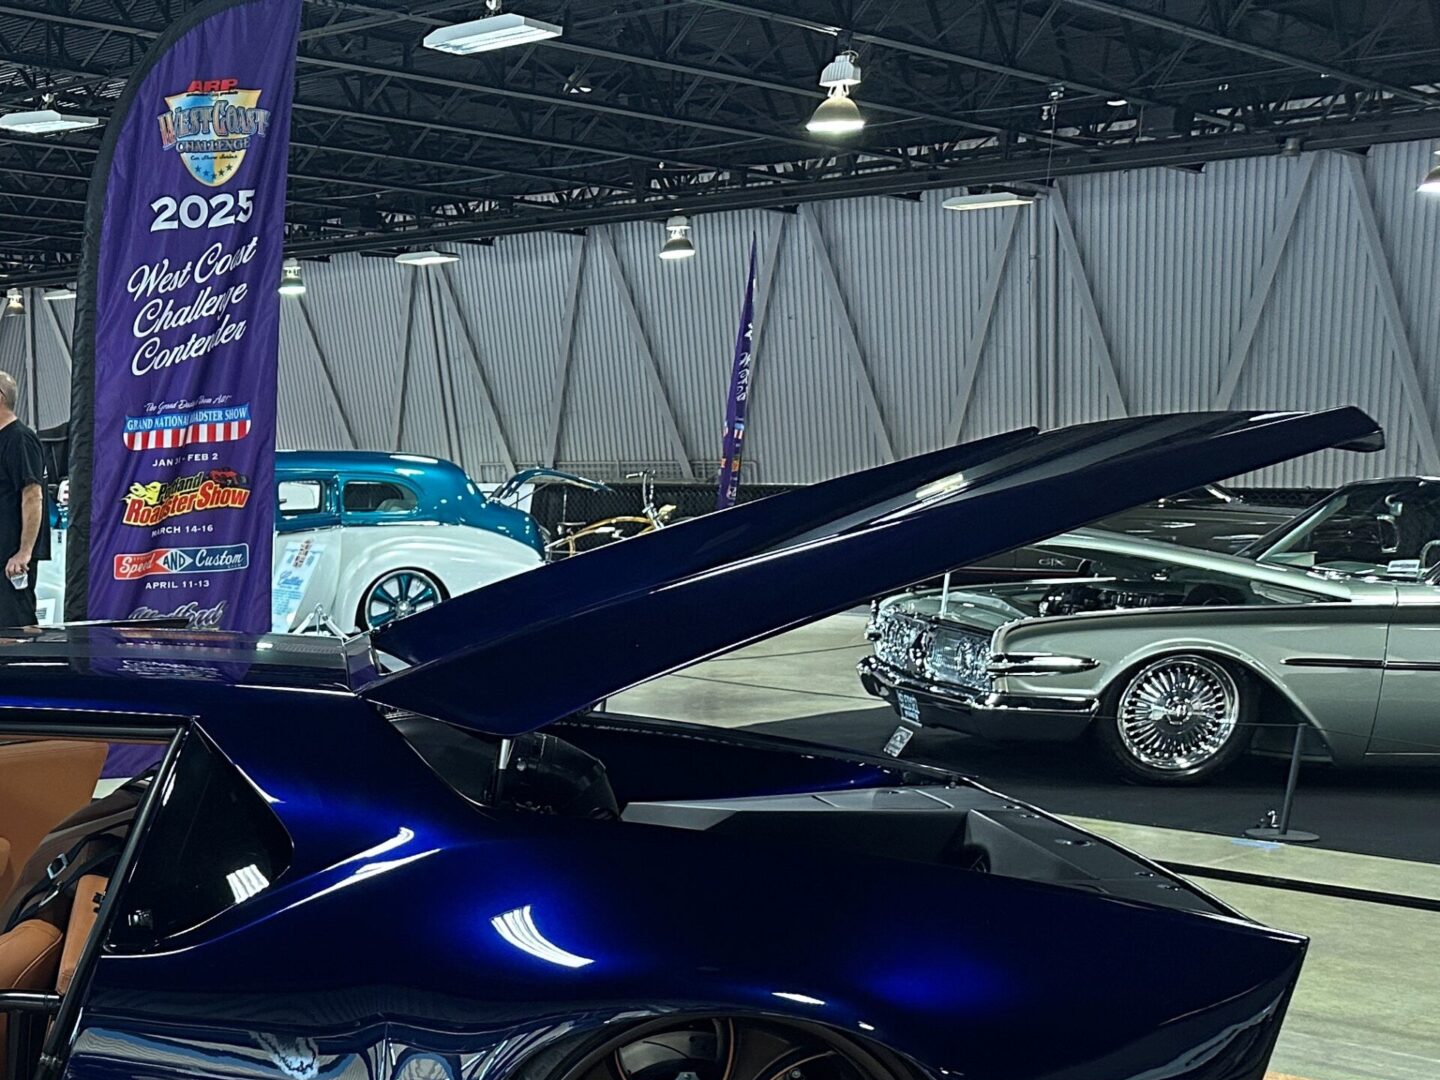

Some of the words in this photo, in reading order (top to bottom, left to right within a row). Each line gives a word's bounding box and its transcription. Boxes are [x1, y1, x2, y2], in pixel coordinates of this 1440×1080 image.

[186, 79, 238, 92] ARP
[176, 137, 251, 153] CHALLENGE
[150, 189, 256, 232] 2025
[127, 258, 193, 302] West
[193, 236, 259, 284] Coast
[132, 282, 248, 338] Challenge
[131, 313, 248, 376] Contender
[127, 418, 153, 431] GRAND
[224, 406, 248, 421] SHOW
[152, 458, 174, 467] JAN
[187, 453, 209, 462] FEB
[211, 452, 218, 461] 2
[195, 480, 250, 509] Show
[151, 525, 181, 538] MARCH
[185, 524, 214, 534] 14-16
[119, 553, 156, 578] Speed
[162, 550, 186, 573] AND
[195, 548, 243, 568] Custom
[145, 580, 179, 590] APRIL
[182, 579, 210, 589] 11-13
